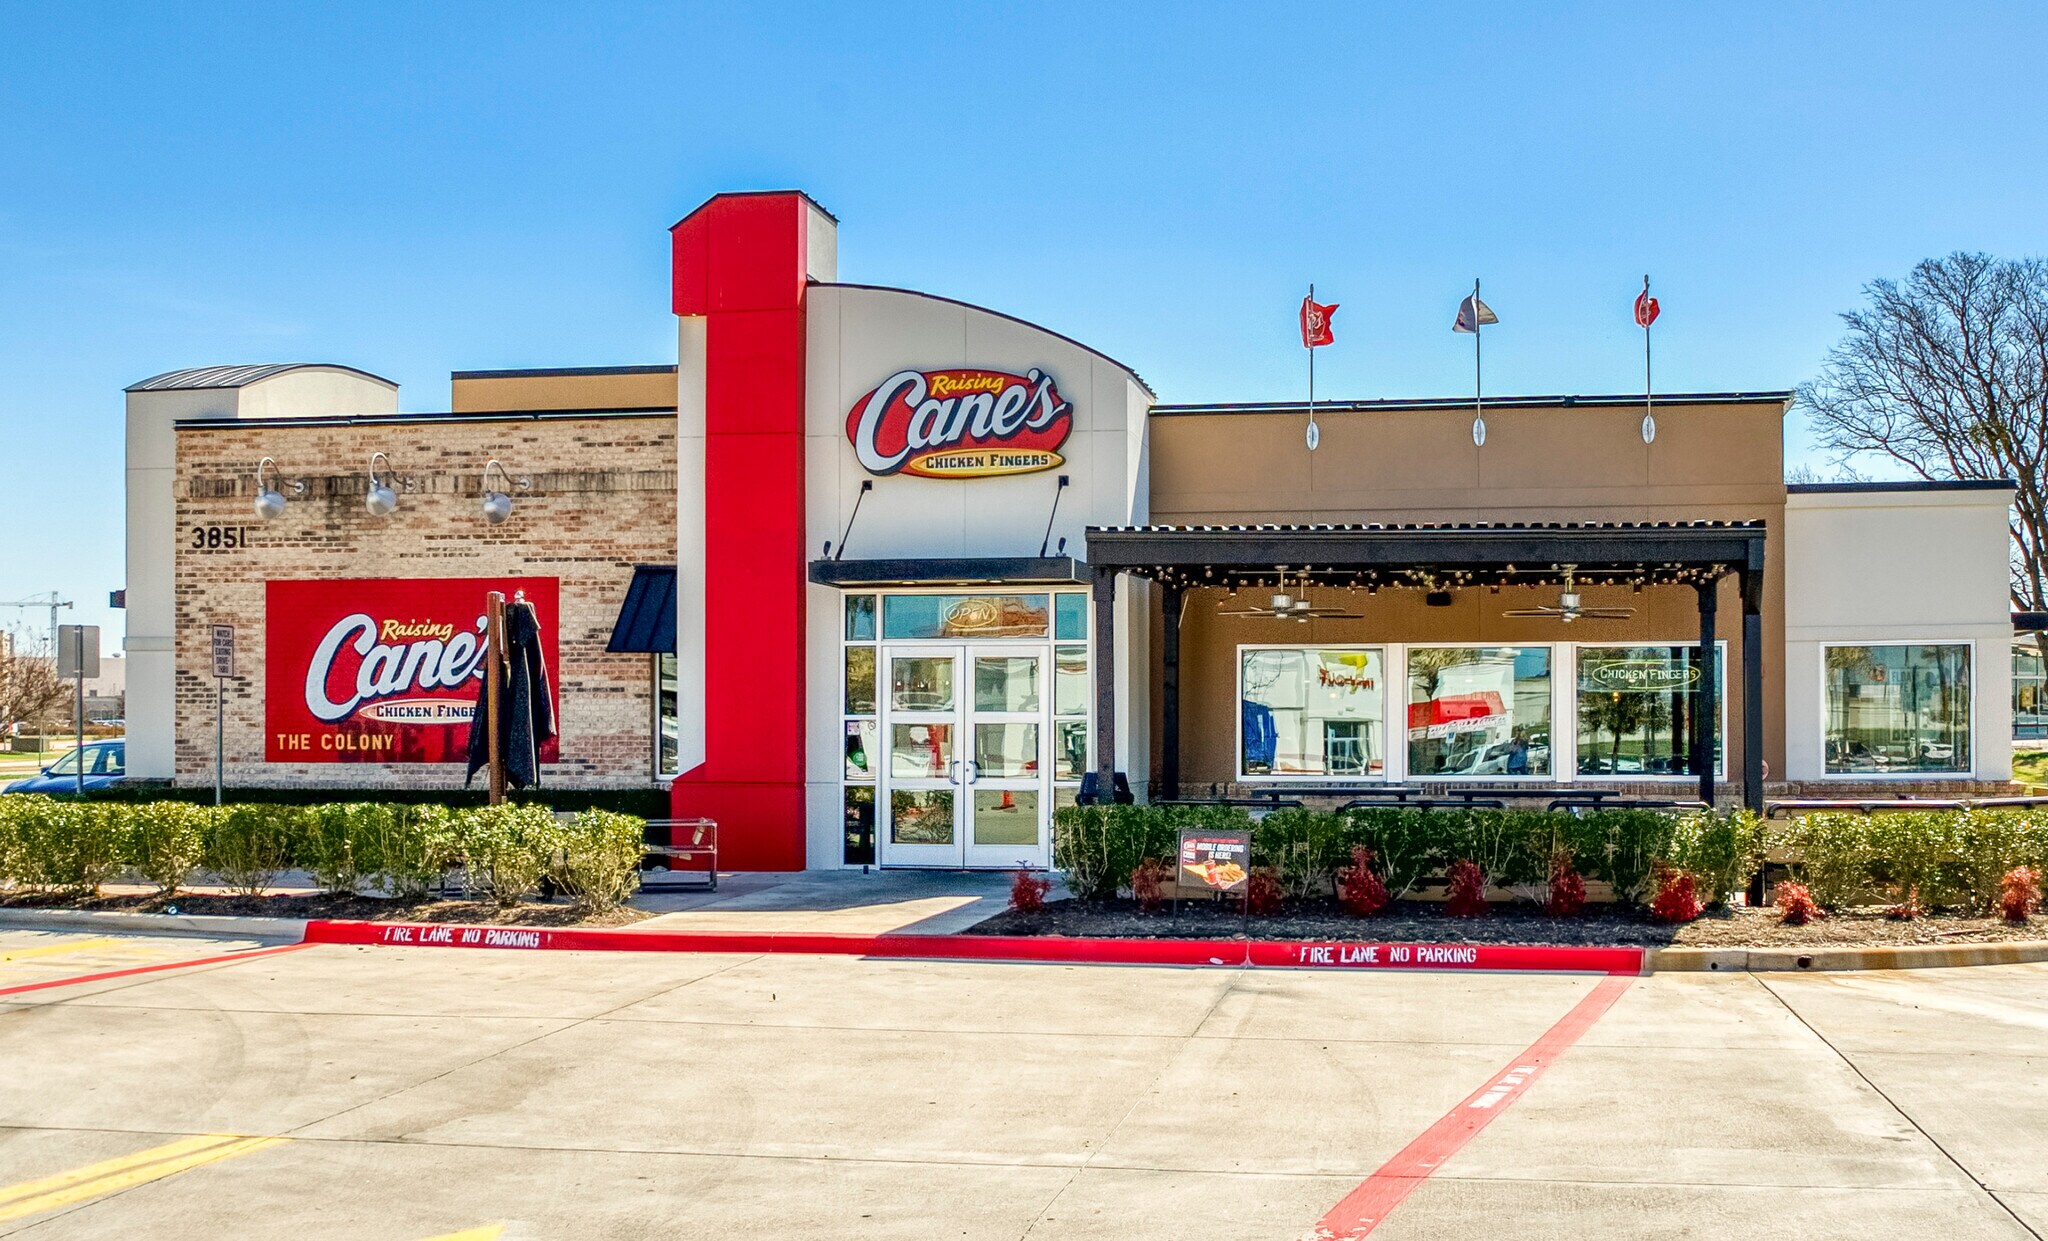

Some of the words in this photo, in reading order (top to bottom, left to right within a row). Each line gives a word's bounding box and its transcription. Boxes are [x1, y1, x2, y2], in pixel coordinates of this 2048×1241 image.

[931, 373, 1004, 396] Raising
[855, 369, 1067, 471] Cane's
[926, 456, 984, 469] CHICKEN
[989, 454, 1048, 467] FINGERS
[191, 526, 246, 549] 3851
[948, 607, 992, 620] OPEN
[380, 619, 454, 642] Raising
[1600, 668, 1646, 680] CHICKEN
[1649, 668, 1696, 680] FINGERS
[376, 704, 432, 718] CHICKEN
[437, 704, 477, 718] FINGE
[277, 733, 311, 751] THE
[320, 733, 395, 751] COLONY
[384, 927, 415, 941] FIRE
[419, 927, 454, 942] LANE
[462, 928, 480, 943] NO
[486, 930, 539, 947] PARKING
[1300, 946, 1334, 963] FIRE
[1340, 946, 1379, 963] LANE
[1390, 947, 1410, 963] NO
[1417, 947, 1477, 963] PARKING
